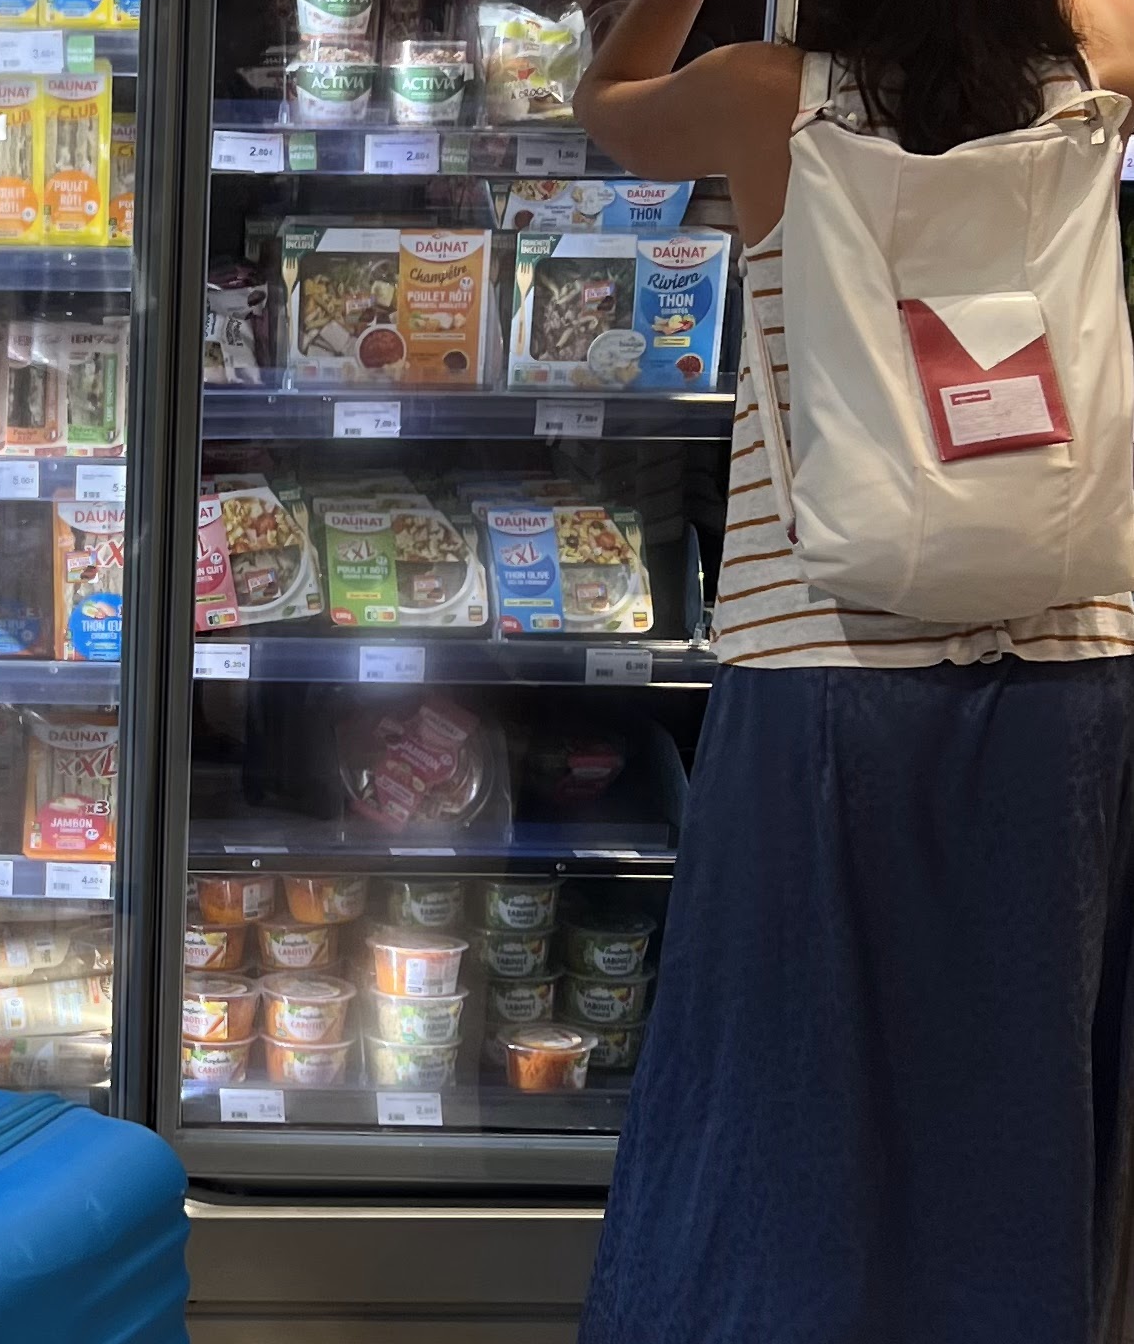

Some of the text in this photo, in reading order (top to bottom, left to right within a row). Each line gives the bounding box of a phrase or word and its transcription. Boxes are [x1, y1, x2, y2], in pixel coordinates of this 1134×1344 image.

[49, 79, 98, 92] DAUNAT
[402, 77, 456, 90] ACTIVIA
[57, 102, 98, 122] CLUB
[54, 181, 88, 193] POULET
[627, 189, 666, 199] DAUNAT
[629, 208, 661, 220] THON
[415, 241, 469, 253] DAUNAT
[653, 246, 707, 258] DAUNAT
[647, 272, 702, 291] Riviera
[407, 288, 472, 302] POULET RÔTI
[658, 293, 694, 308] THON
[74, 510, 125, 524] DAUNA
[332, 515, 384, 527] DAUNAT
[494, 516, 547, 528] DAUNAT
[337, 566, 367, 575] POULET
[505, 571, 526, 579] THON
[82, 619, 105, 632] THON
[48, 730, 108, 743] DAUNAT
[51, 818, 93, 829] JAMBON
